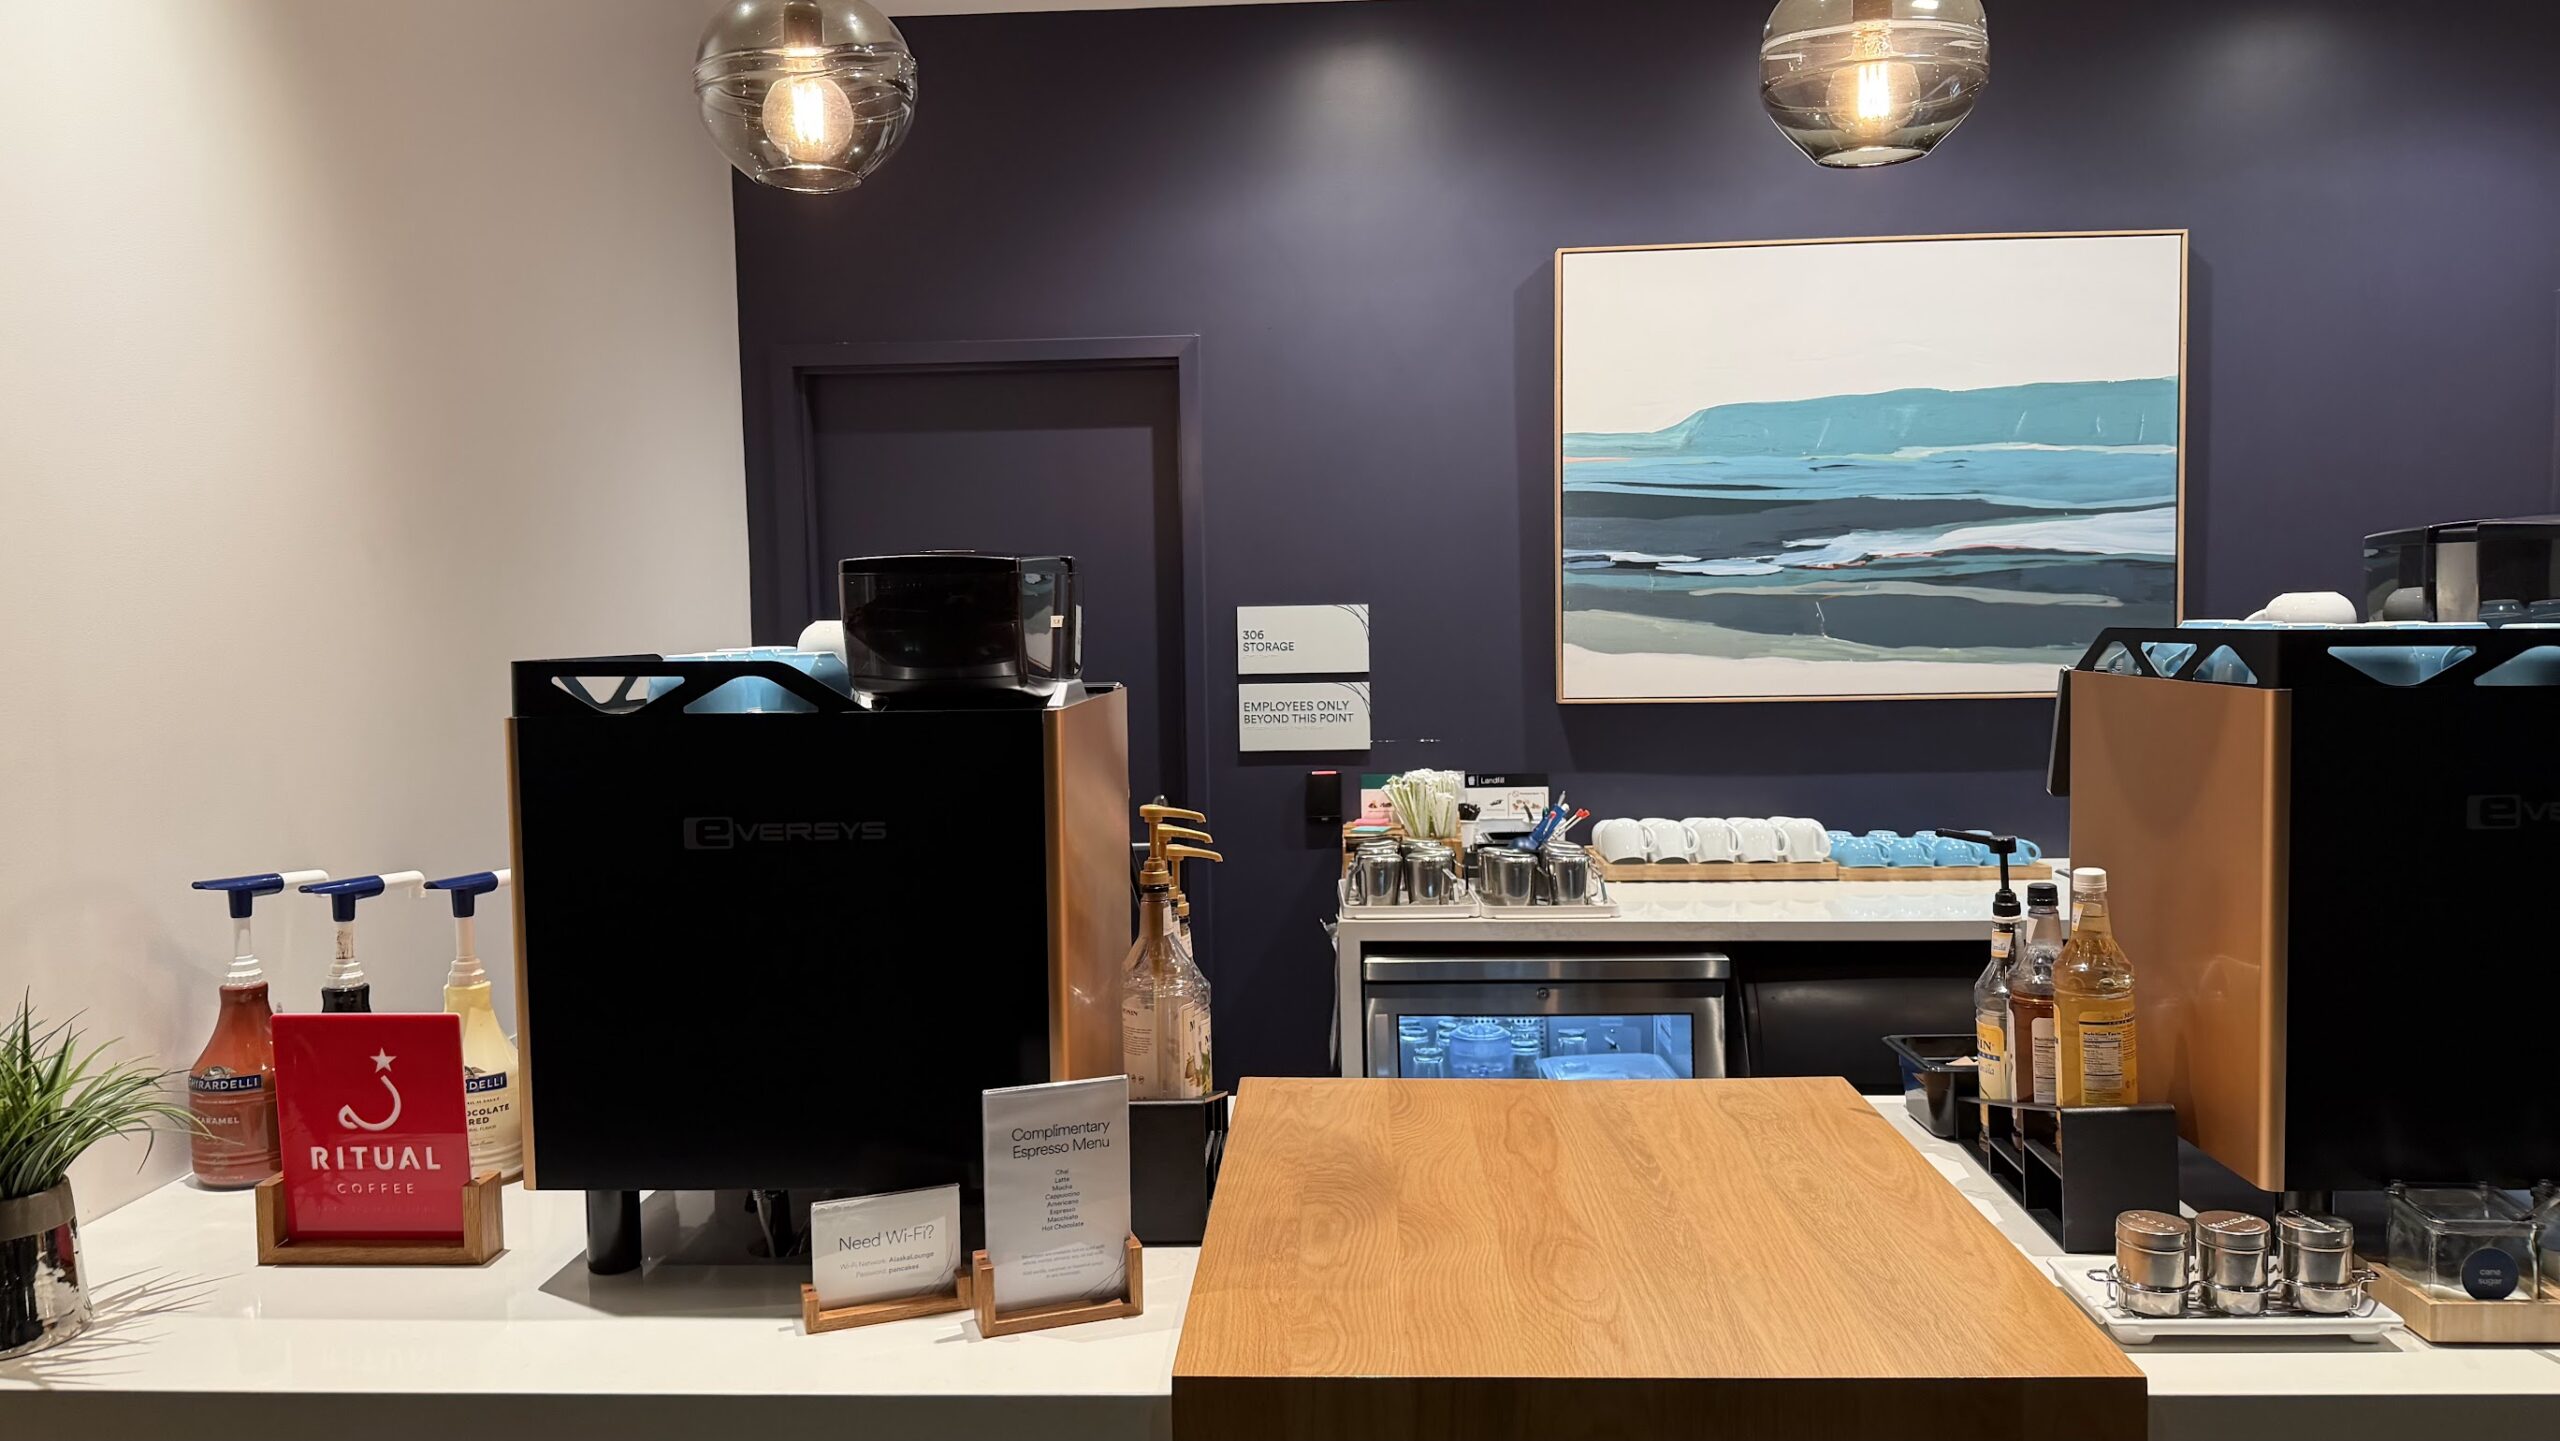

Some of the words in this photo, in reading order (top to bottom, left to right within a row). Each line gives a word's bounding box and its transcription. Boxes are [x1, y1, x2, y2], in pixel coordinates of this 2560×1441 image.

[1242, 630, 1264, 640] 306
[1243, 642, 1295, 652] STORAGE
[1243, 701, 1314, 712] EMPLOYEES
[1316, 700, 1350, 711] ONLY
[1243, 714, 1290, 725] BEYOND
[1292, 713, 1317, 723] THIS
[1319, 713, 1354, 723] POINT
[1480, 776, 1505, 785] Landfill
[467, 1076, 503, 1091] DELLI
[1011, 1121, 1110, 1142] Complimentary
[1012, 1143, 1069, 1160] Espresso
[1072, 1137, 1110, 1151] Menu
[310, 1145, 441, 1171] RITUAL
[337, 1182, 414, 1195] COFFEE
[839, 1231, 881, 1252] Need
[885, 1224, 935, 1245] Wi-Fi?
